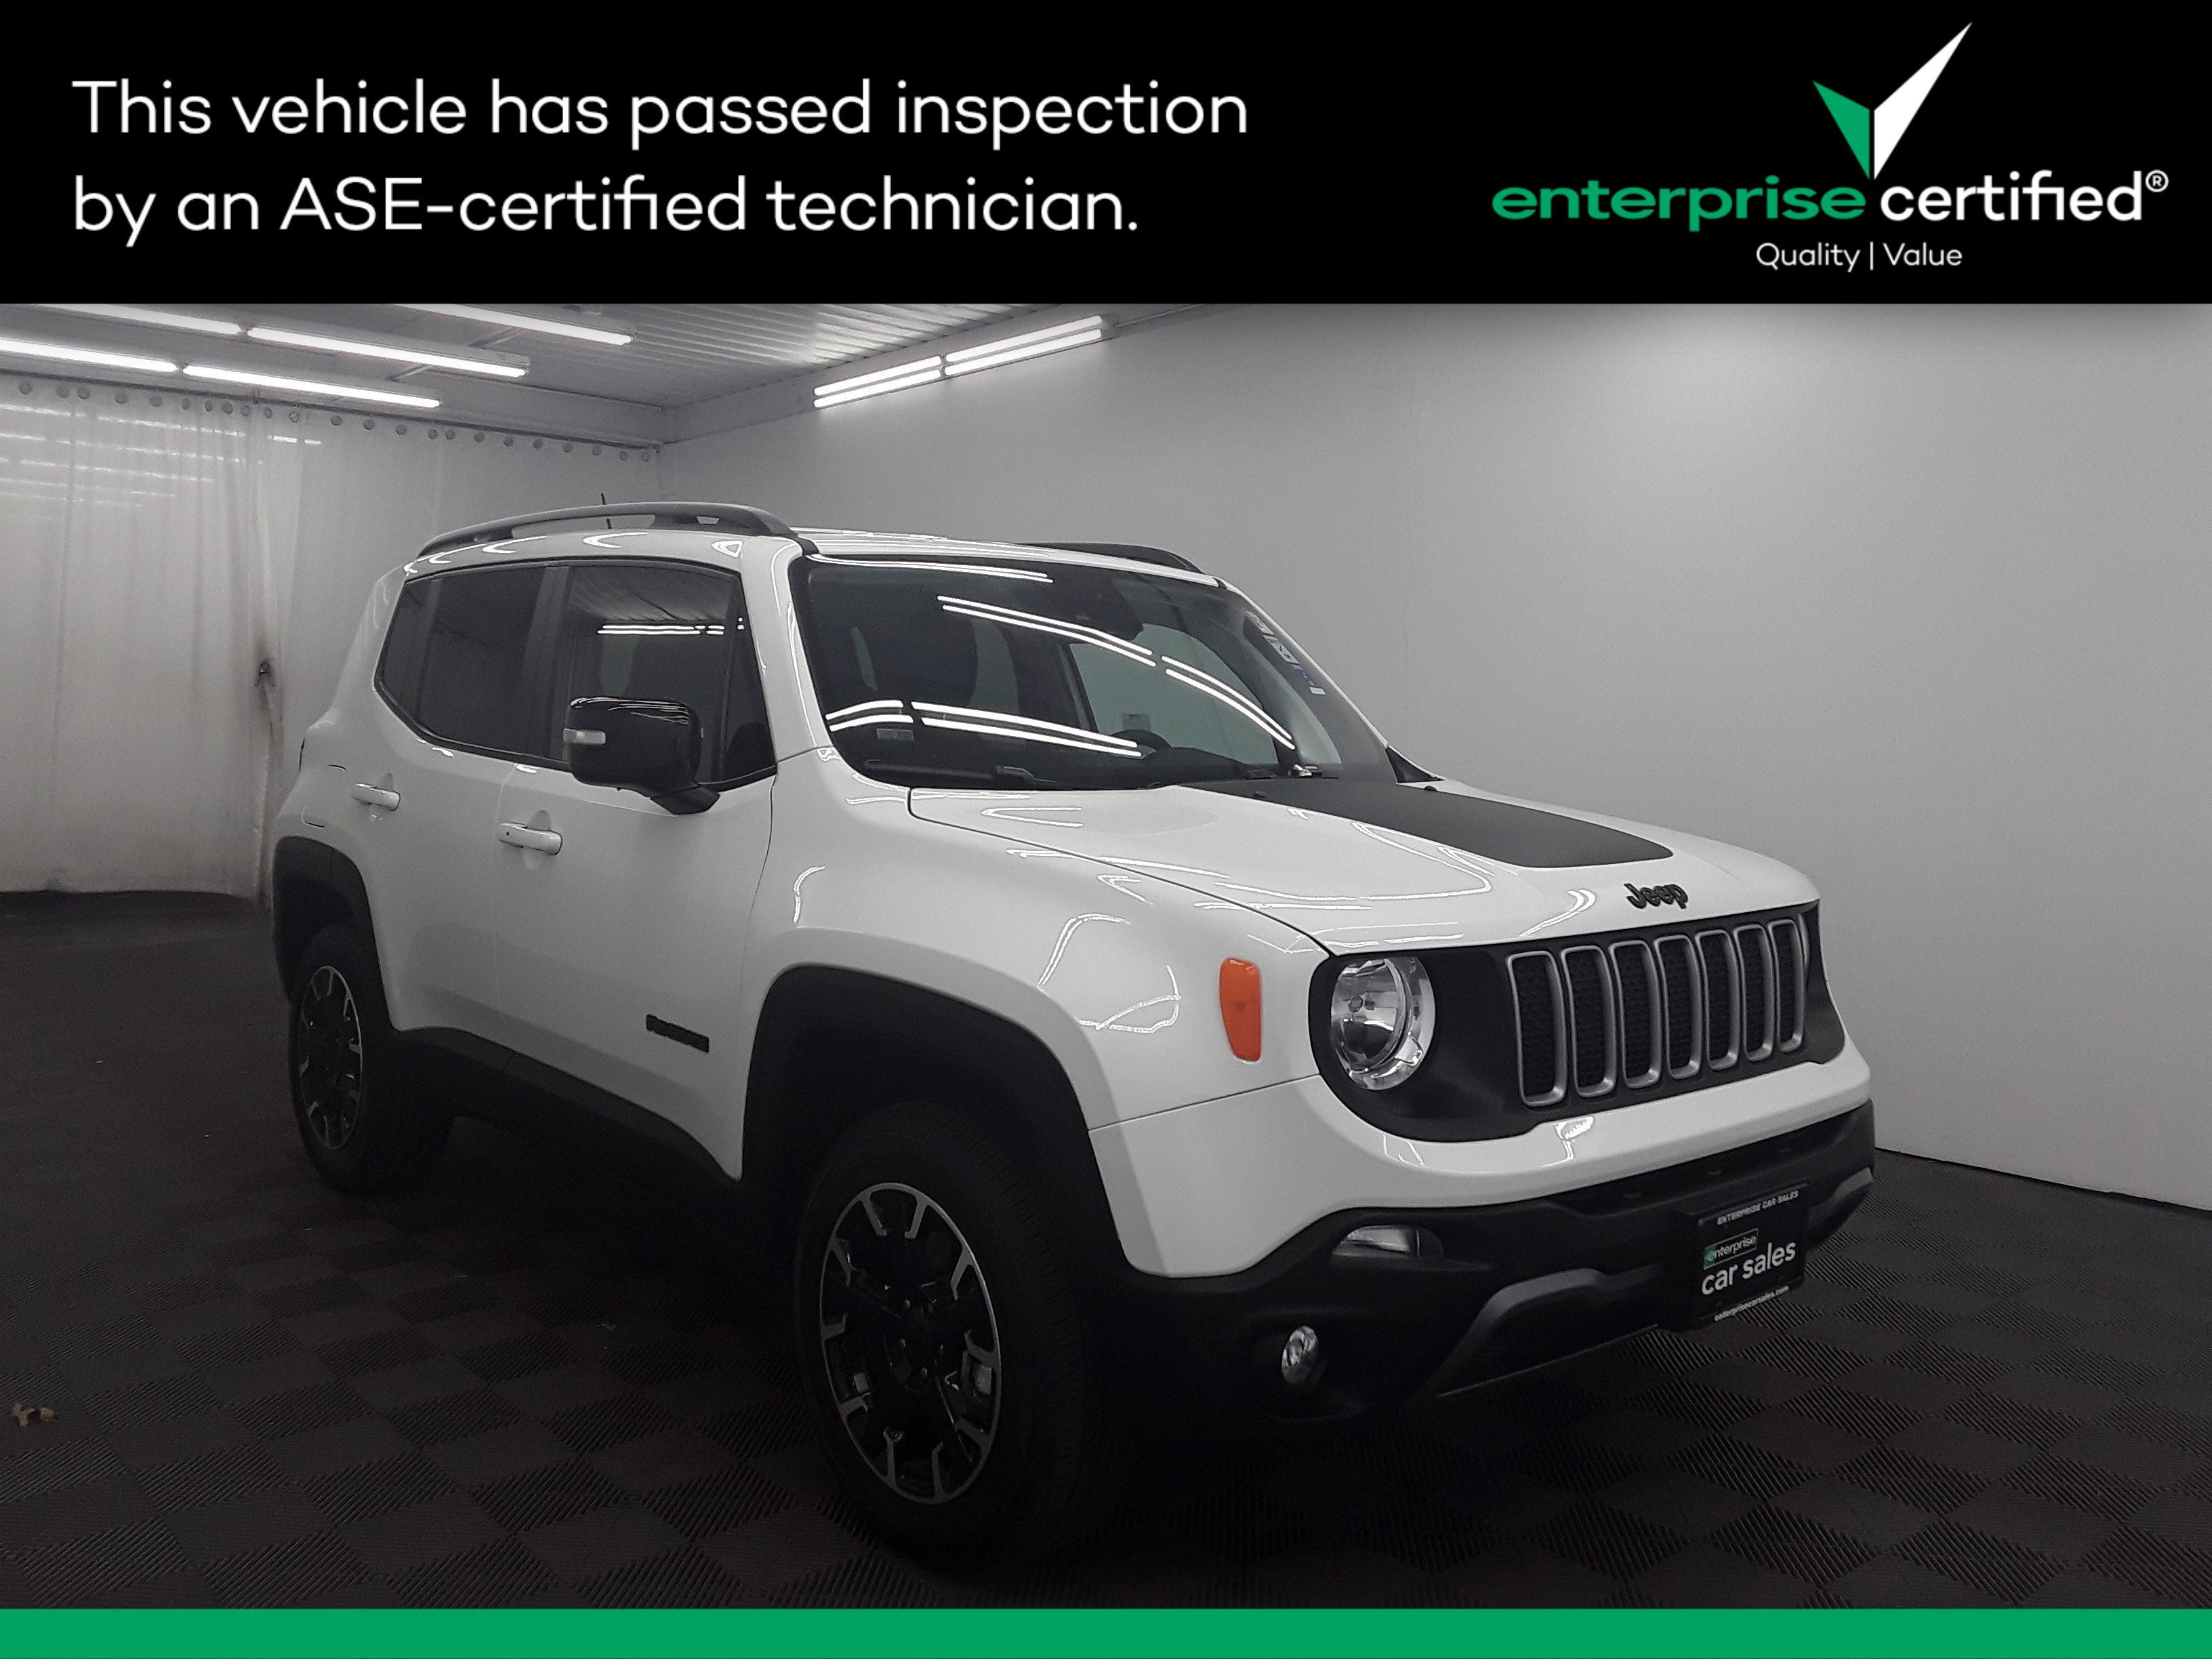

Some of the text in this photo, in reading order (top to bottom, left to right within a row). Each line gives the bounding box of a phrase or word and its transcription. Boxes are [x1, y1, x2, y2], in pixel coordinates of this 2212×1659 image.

[1624, 883, 1688, 909] Jeep
[1705, 1235, 1757, 1262] enterprise
[1701, 1242, 1796, 1295] car sales
